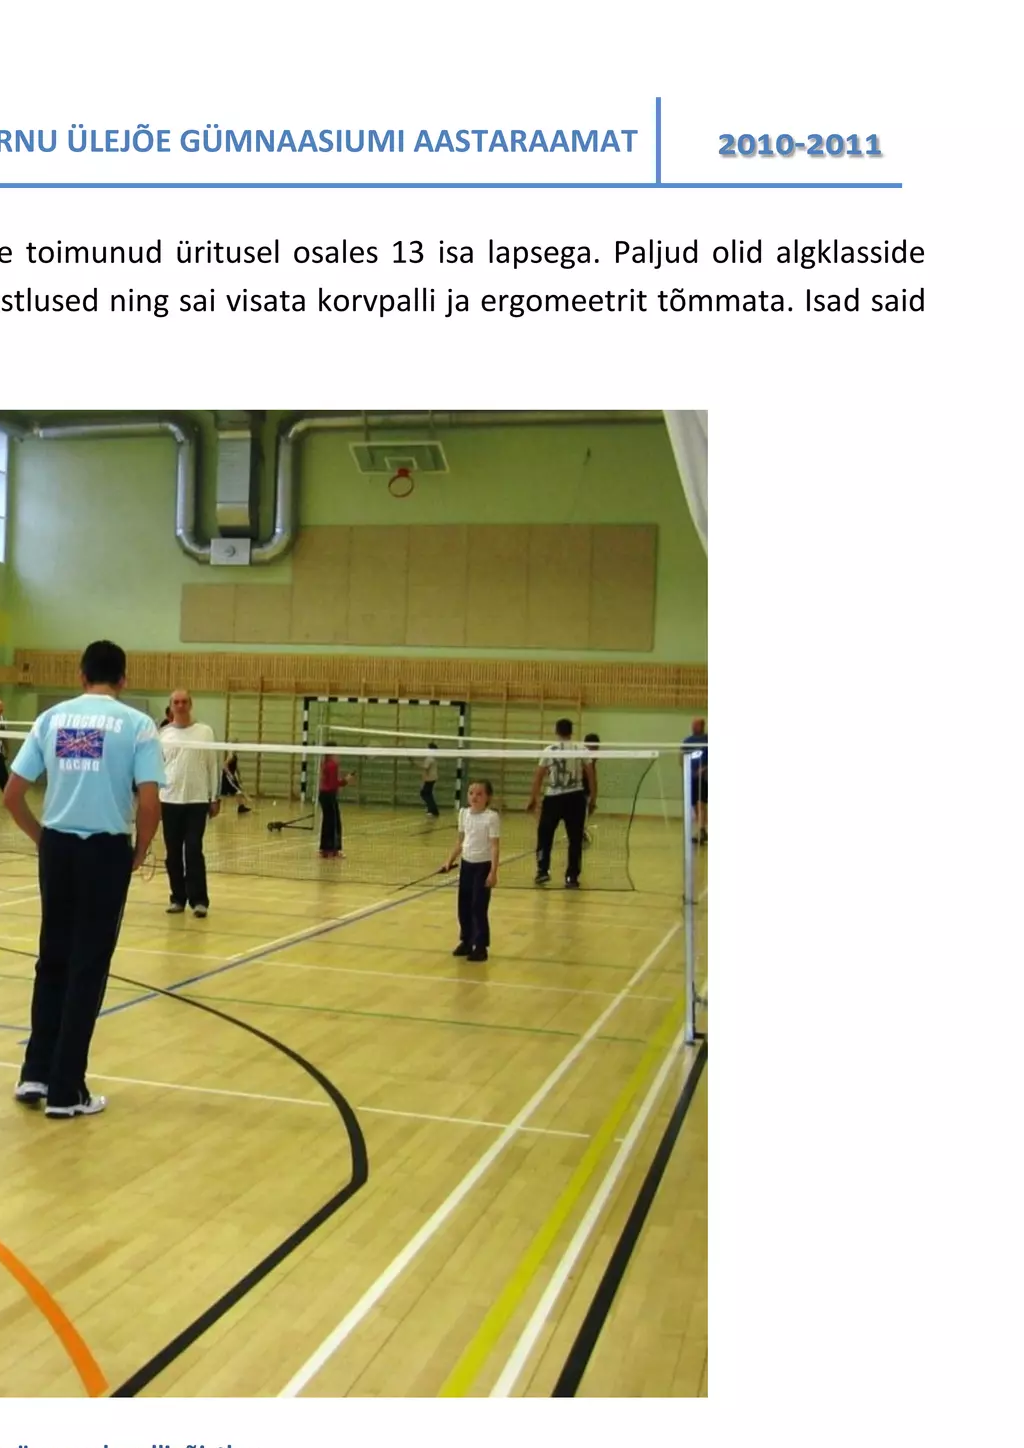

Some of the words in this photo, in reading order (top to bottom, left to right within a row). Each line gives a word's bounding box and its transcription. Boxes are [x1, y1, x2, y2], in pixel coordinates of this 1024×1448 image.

[67, 123, 171, 153] ÜLEJÕE
[179, 123, 405, 153] GÜMNAASIUMI
[413, 129, 639, 153] AASTARAAMAT
[718, 133, 883, 158] 2010-2011
[25, 238, 162, 264] toimunud
[176, 238, 280, 264] üritusel
[293, 238, 379, 264] osales
[392, 239, 425, 264] 13
[439, 239, 474, 264] isa
[488, 238, 600, 270] lapsega.
[615, 238, 698, 270] Paljud
[712, 238, 762, 264] olid
[776, 238, 925, 270] algklasside
[110, 288, 170, 318] ning
[179, 288, 215, 313] sai
[225, 288, 306, 313] visata
[318, 286, 435, 318] korvpalli
[444, 288, 469, 318] ja
[480, 288, 648, 319] ergomeetrit
[657, 287, 793, 313] tõmmata.
[806, 287, 860, 313] Isad
[871, 287, 925, 313] said
